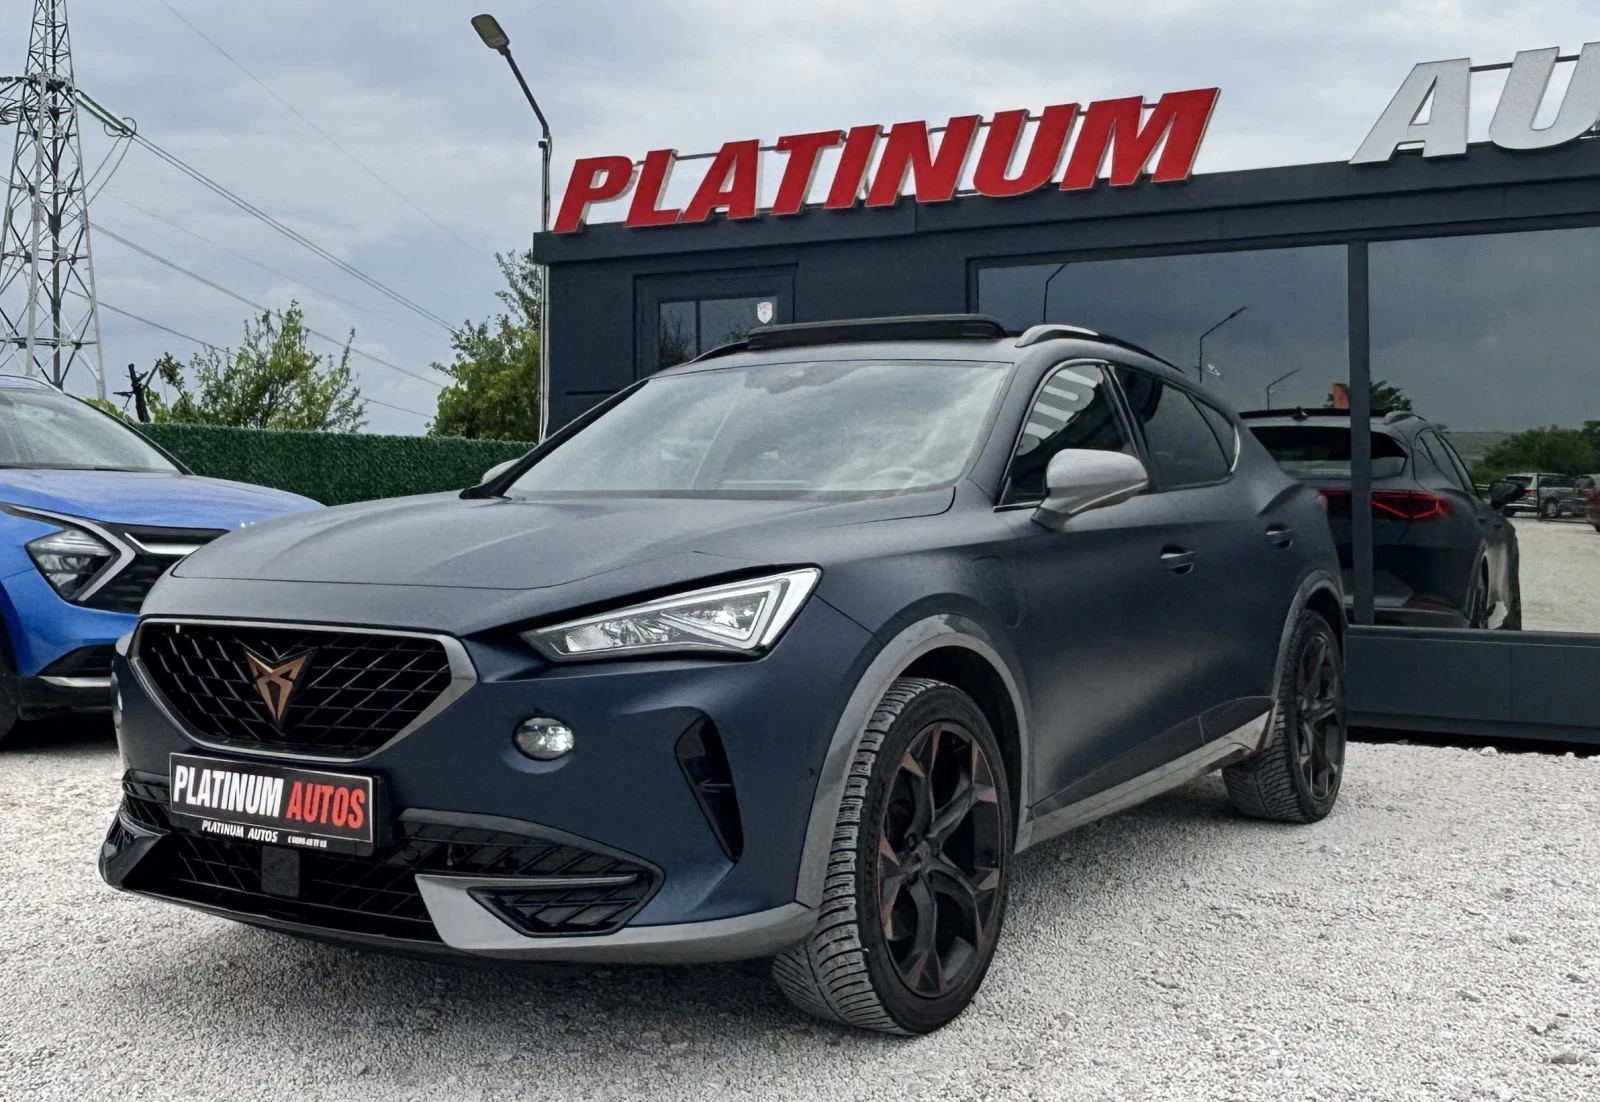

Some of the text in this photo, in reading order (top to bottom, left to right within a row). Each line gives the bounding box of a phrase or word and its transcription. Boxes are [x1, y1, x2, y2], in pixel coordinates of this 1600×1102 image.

[553, 87, 1221, 233] PLATINUM
[173, 765, 366, 829] PLATINUM AUTOS
[201, 819, 244, 838] PLATINUM
[247, 828, 279, 844] AUTOS
